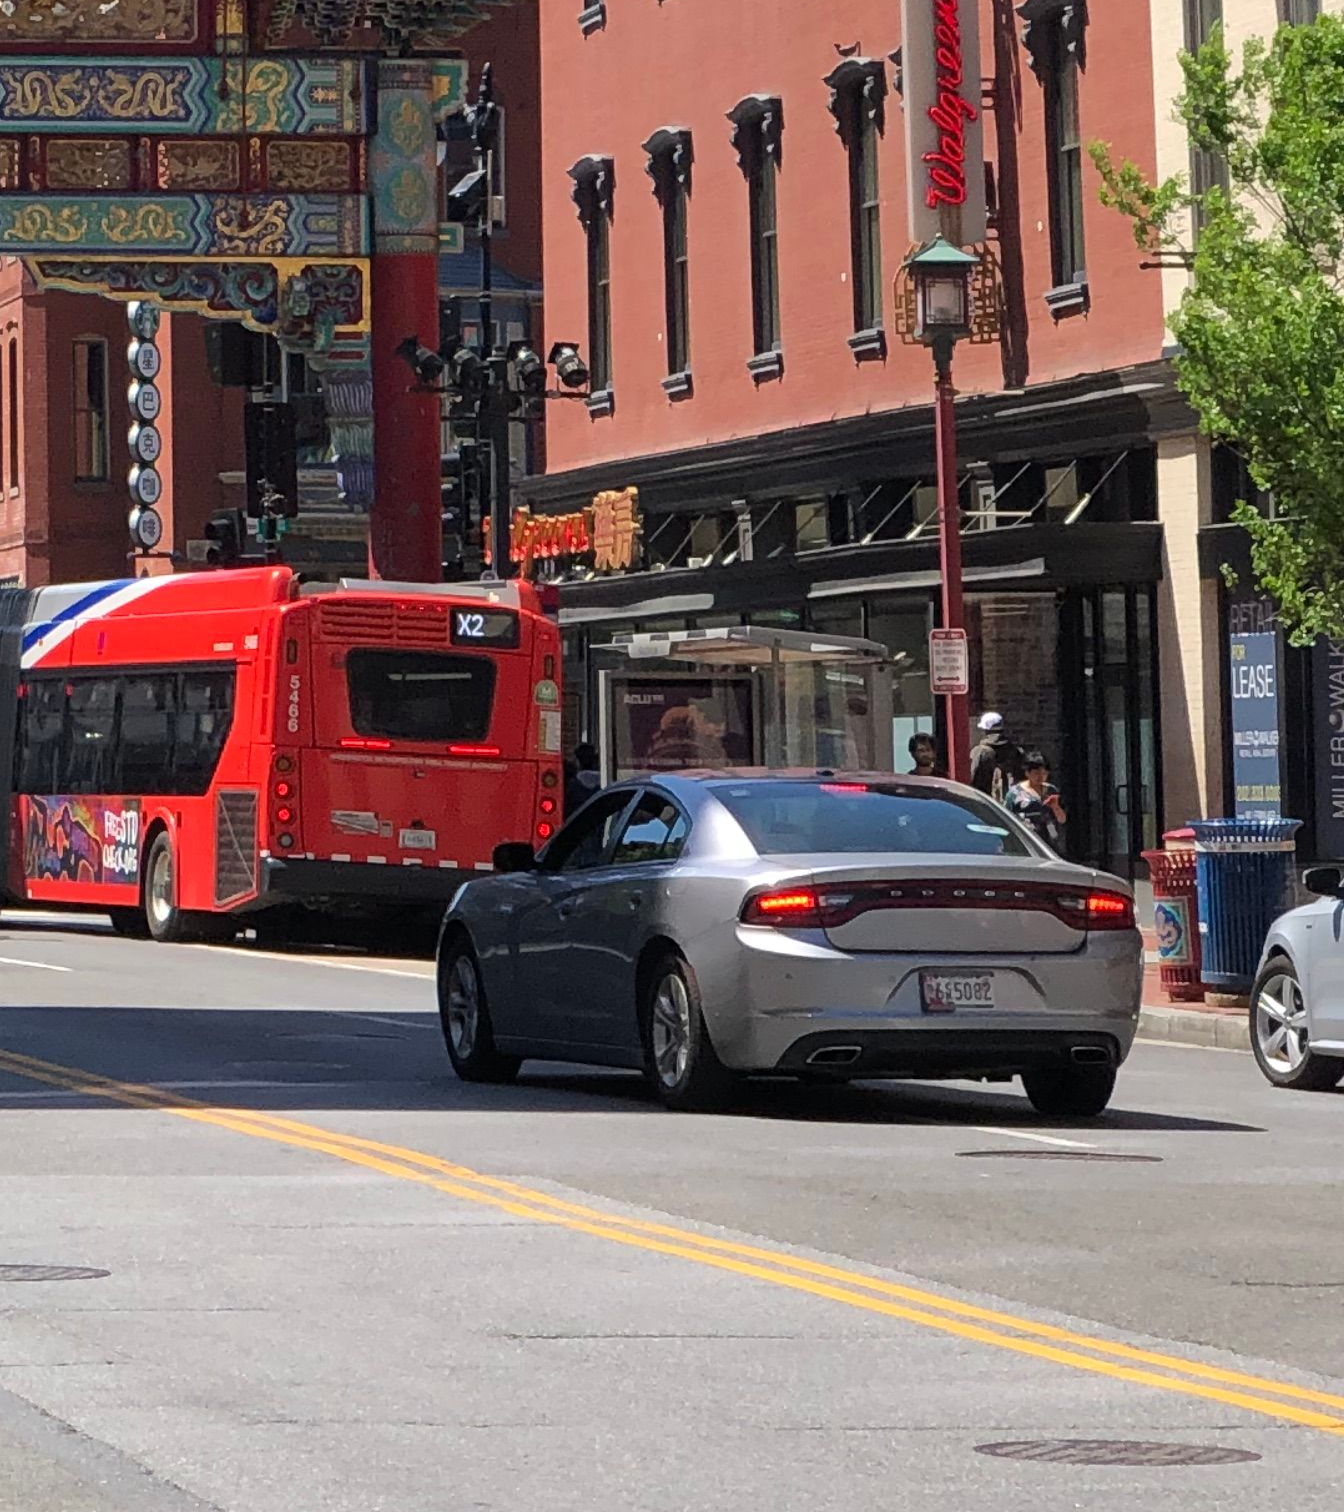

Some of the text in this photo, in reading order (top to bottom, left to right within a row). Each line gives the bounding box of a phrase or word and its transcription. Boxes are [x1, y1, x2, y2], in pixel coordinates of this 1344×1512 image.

[456, 613, 485, 637] X2
[1232, 664, 1275, 698] LEASE
[287, 674, 301, 733] 5466
